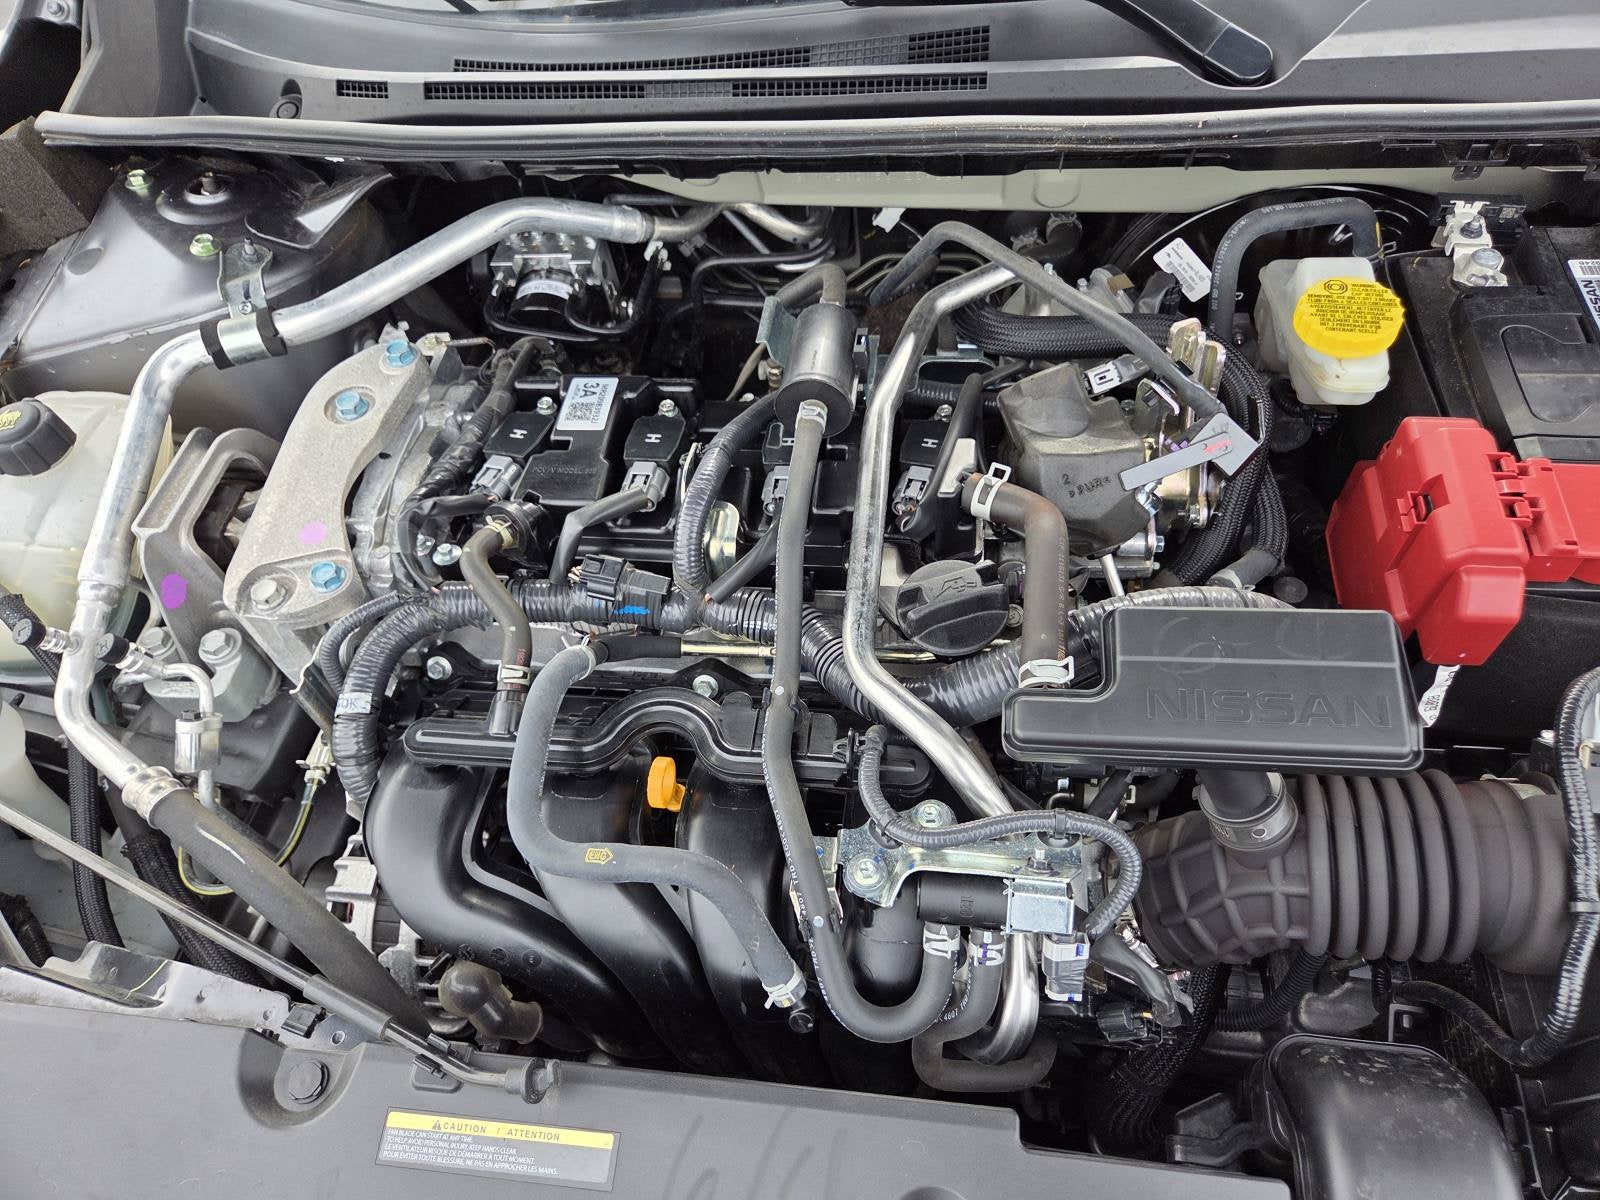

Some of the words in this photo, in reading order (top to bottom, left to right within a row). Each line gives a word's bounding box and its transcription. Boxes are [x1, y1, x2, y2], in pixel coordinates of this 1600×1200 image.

[580, 382, 600, 398] 3A
[1146, 686, 1393, 728] NISSAN
[444, 1122, 486, 1133] CAUTION
[508, 1128, 560, 1141] ATTENTION
